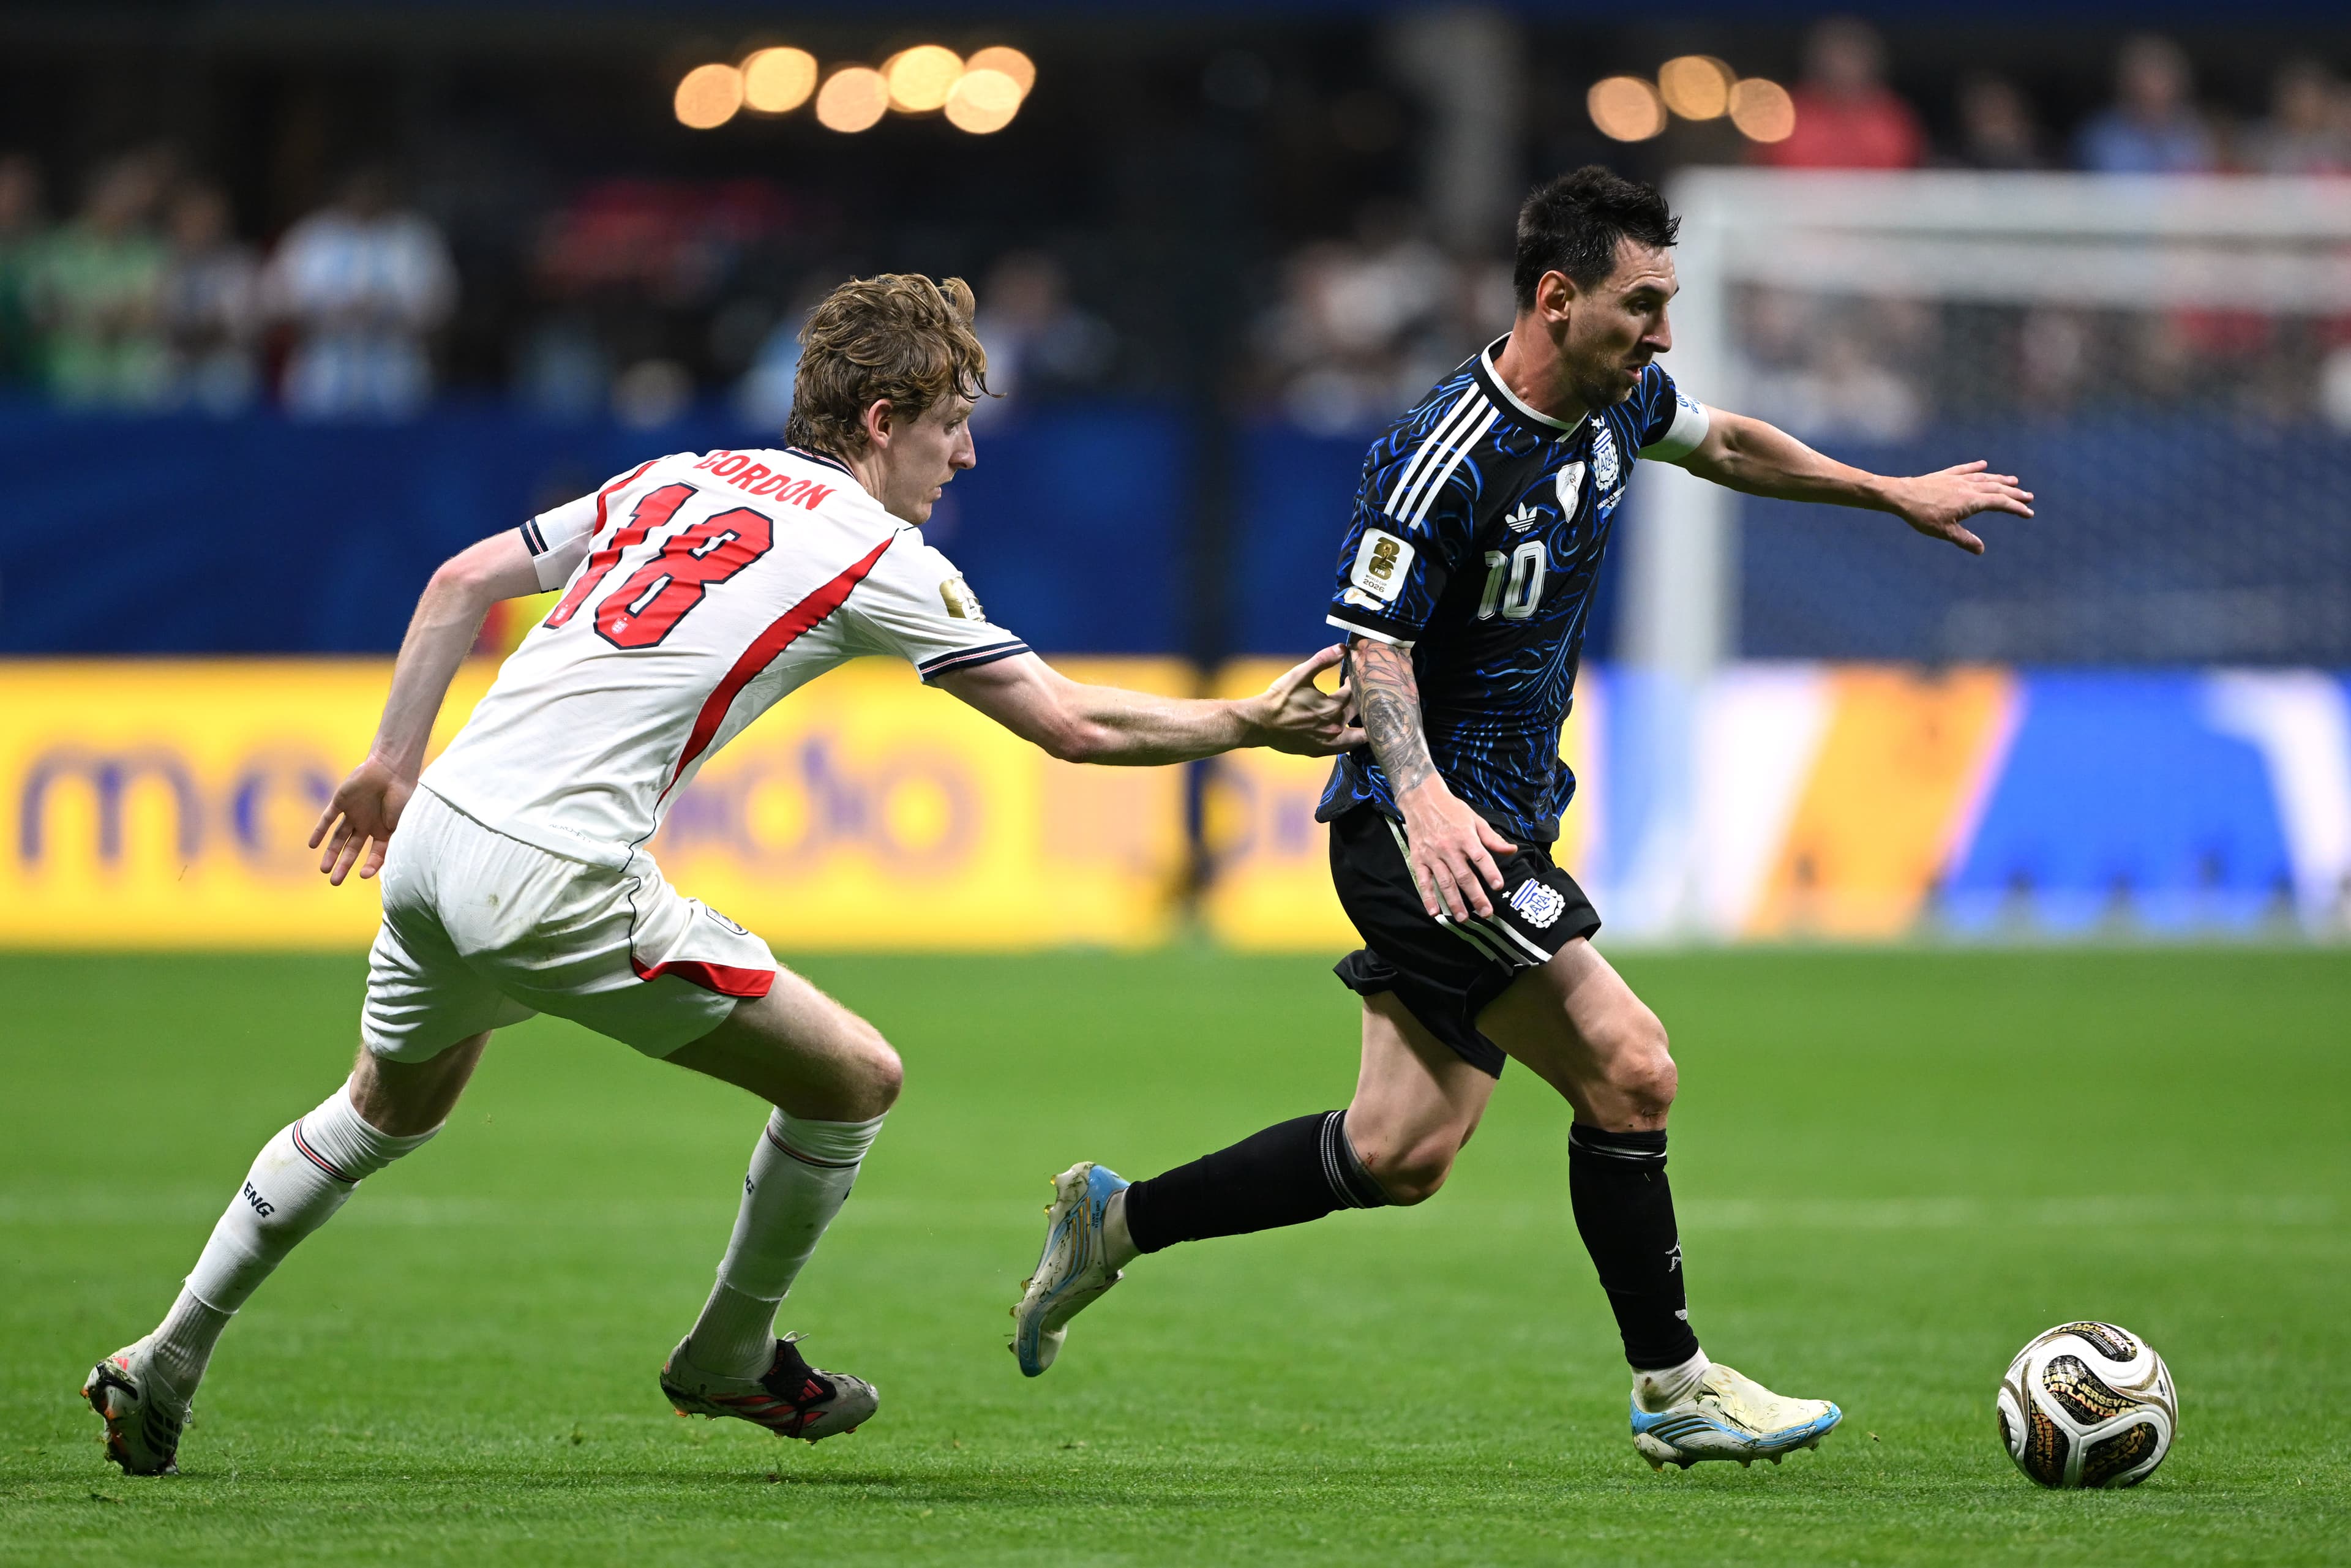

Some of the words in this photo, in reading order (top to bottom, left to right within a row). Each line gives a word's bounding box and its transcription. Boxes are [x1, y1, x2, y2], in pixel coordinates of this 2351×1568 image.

[692, 451, 838, 511] GORDON
[542, 481, 774, 651] 18
[1477, 540, 1547, 621] 10
[1363, 579, 1385, 593] 2026
[1525, 892, 1551, 916] AFA
[244, 1180, 275, 1218] ENG
[2047, 1382, 2118, 1418] ATLANTA
[2077, 1382, 2123, 1407] JERSEY
